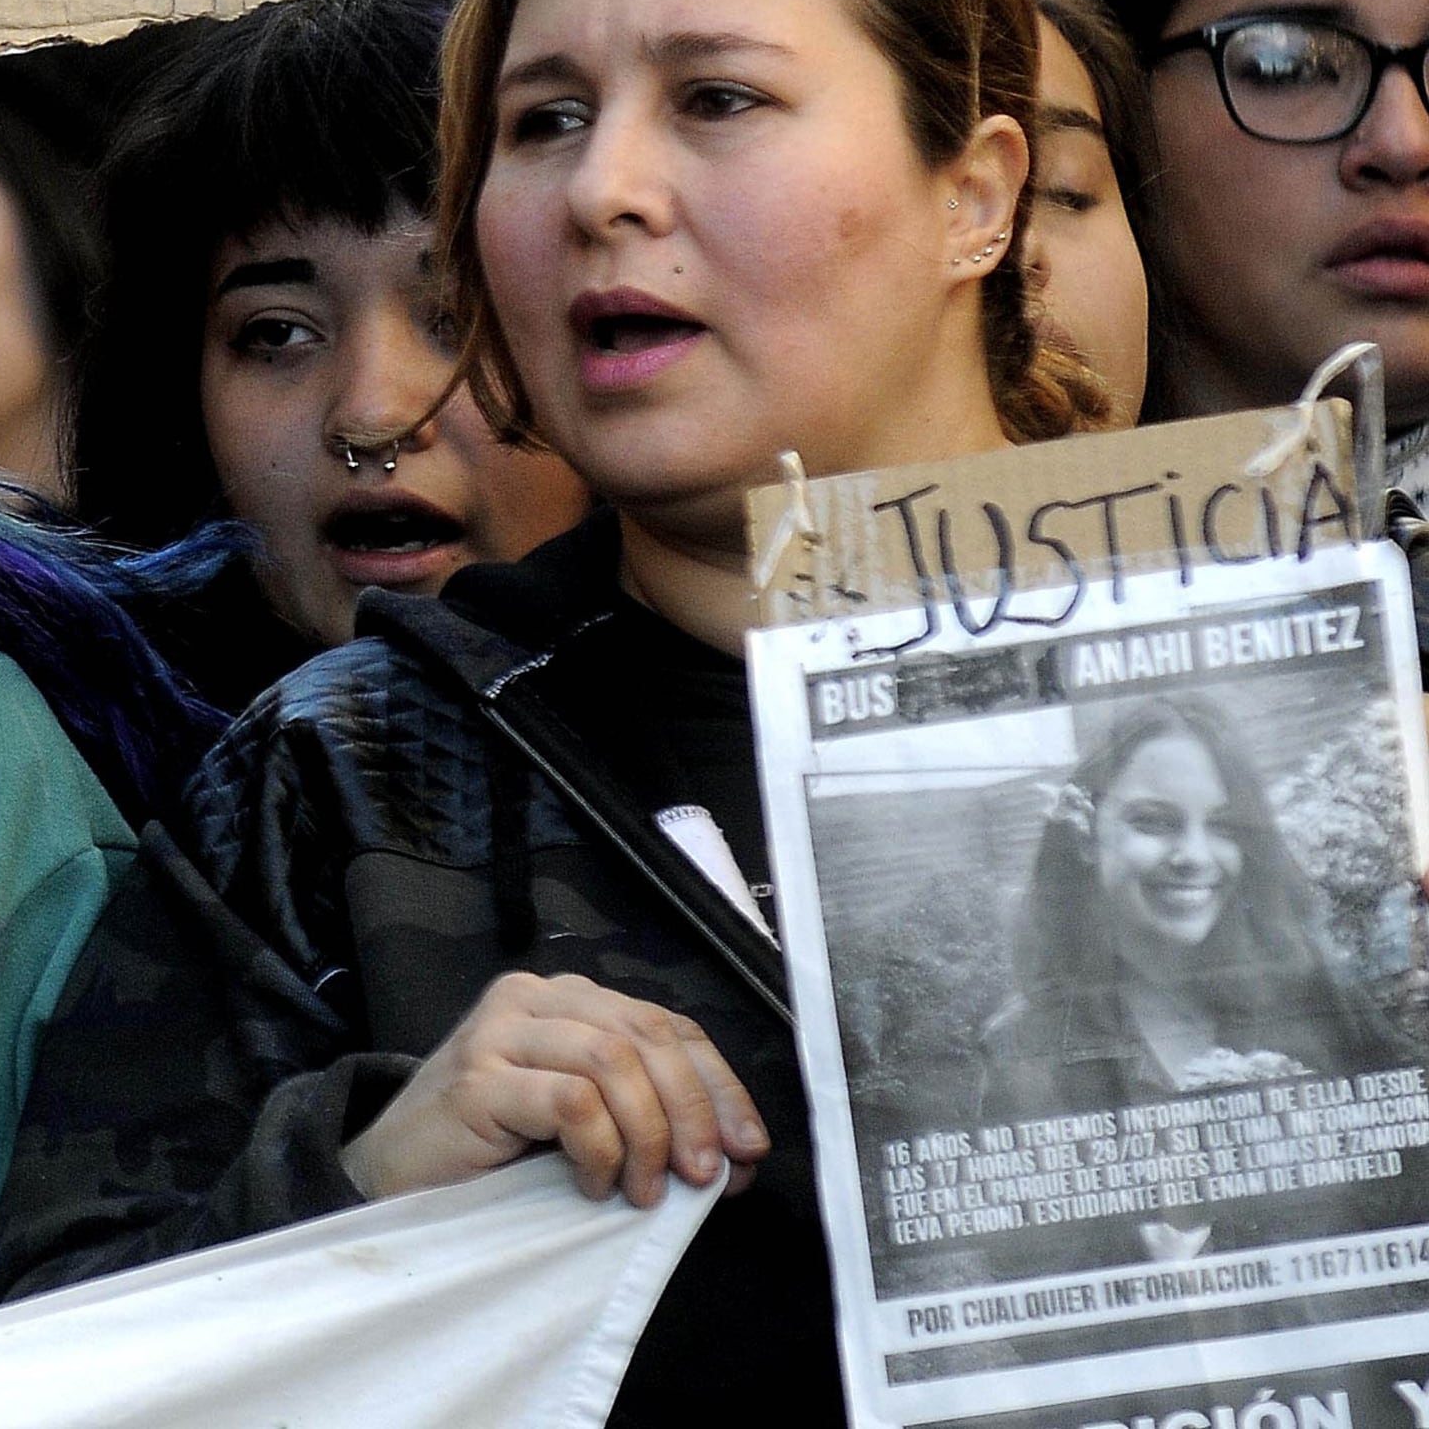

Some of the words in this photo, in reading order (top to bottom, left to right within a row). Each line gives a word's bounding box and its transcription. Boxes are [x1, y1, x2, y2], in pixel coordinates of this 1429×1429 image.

[1071, 631, 1193, 687] ANAHI
[1206, 606, 1365, 669] BENITEZ
[887, 1141, 911, 1167] 16
[984, 1126, 1015, 1154] NO
[1019, 1112, 1118, 1148] TENEMOS
[1123, 1091, 1263, 1135] INFORMACION
[1268, 1086, 1297, 1113] DE
[1304, 1078, 1356, 1108] ELLA
[1360, 1068, 1428, 1101] DESDE
[889, 1165, 926, 1194] LAS
[934, 1160, 959, 1187] 17
[967, 1149, 1037, 1182] HORAS
[1044, 1143, 1085, 1171] DEL
[1171, 1125, 1200, 1153] SU
[1206, 1114, 1283, 1149] ULTIMA
[1291, 1094, 1429, 1138] INFORMACION
[892, 1192, 929, 1219] FUE
[933, 1187, 960, 1213] EN
[964, 1182, 988, 1209] EL
[991, 1170, 1074, 1205] PARQUE
[1075, 1166, 1103, 1192] DE
[1107, 1150, 1209, 1189] DEPORTES
[1213, 1146, 1238, 1172] DE
[1243, 1136, 1317, 1169] LOMAS
[1318, 1132, 1346, 1158] DE
[1034, 1183, 1159, 1227] ESTUDIANTE
[1161, 1180, 1204, 1208] DEL
[1208, 1171, 1267, 1202] ENAM
[1272, 1166, 1299, 1192] DE
[1302, 1151, 1403, 1189] BANFIELD
[907, 1302, 956, 1339] POR
[962, 1284, 1098, 1329] CUALQUIER
[1104, 1258, 1283, 1310] INFORMACION:
